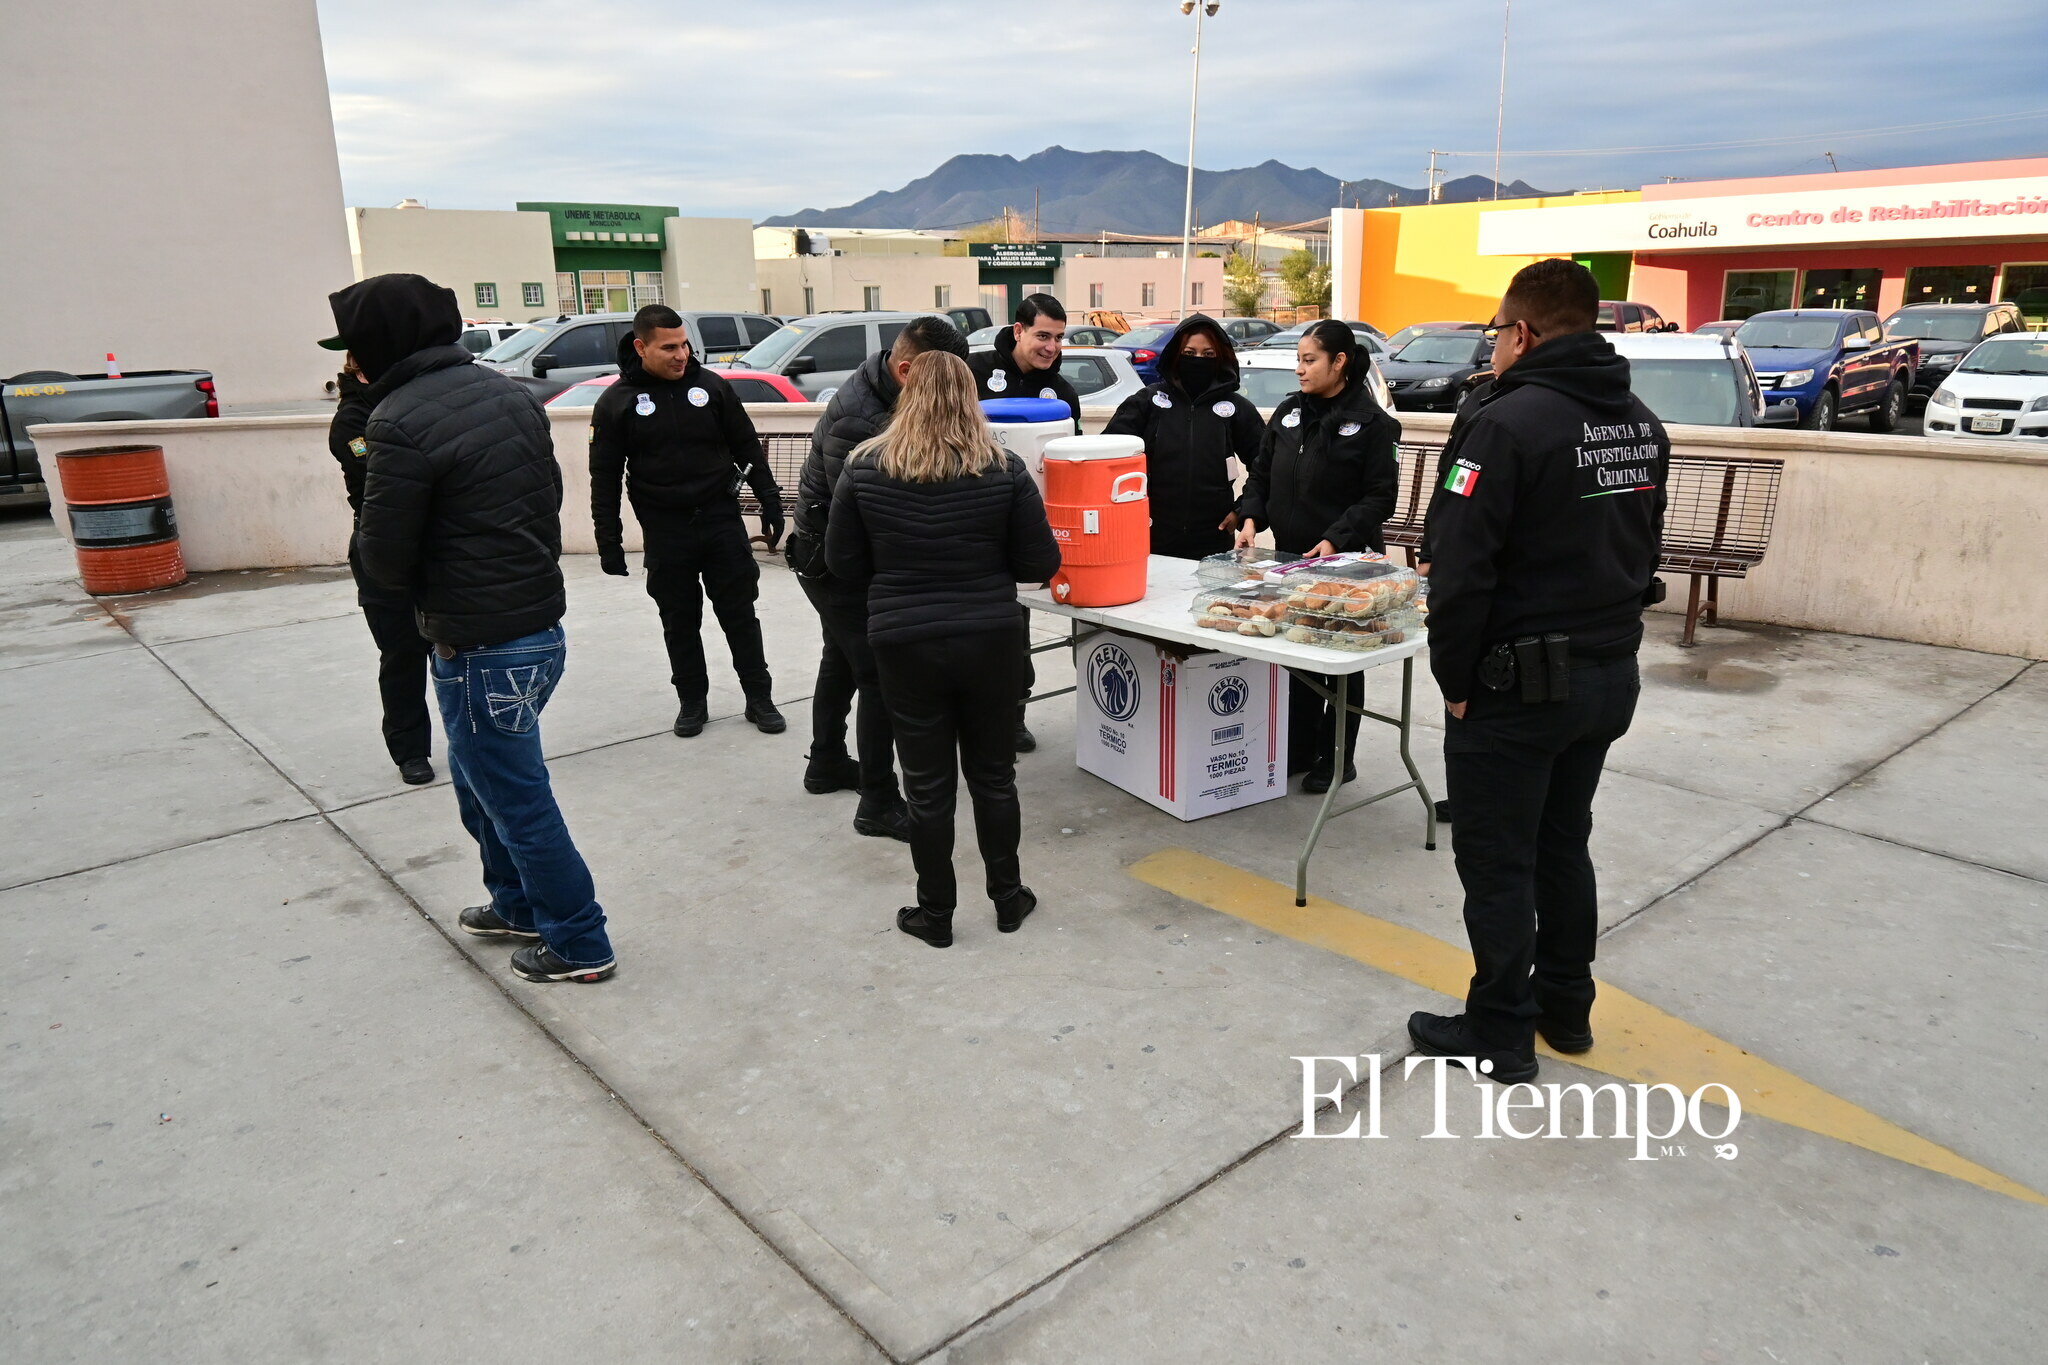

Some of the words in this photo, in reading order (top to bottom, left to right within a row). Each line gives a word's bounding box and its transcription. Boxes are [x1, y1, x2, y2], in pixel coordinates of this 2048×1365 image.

[564, 210, 591, 220] UNEME
[593, 210, 641, 221] METABOLICA
[1746, 209, 1824, 228] Centro
[1830, 206, 1862, 224] de
[1868, 196, 2048, 222] Rehabilitación
[1648, 221, 1718, 239] Coahuila
[15, 385, 66, 397] AIC-05
[1639, 422, 1653, 437] DE
[1575, 441, 1659, 468] INVESTIGACIÓN
[1456, 458, 1482, 471] MÉXICO
[1095, 647, 1134, 683] REYMA
[1214, 677, 1244, 694] REYMA
[1101, 723, 1112, 733] VASO
[1099, 728, 1127, 749] TERMICO
[1110, 743, 1125, 755] PIEZAS
[1206, 756, 1249, 773] TERMICO
[1210, 753, 1228, 763] VASO
[1209, 771, 1223, 779] 1000
[1224, 766, 1246, 776] PIEZAS
